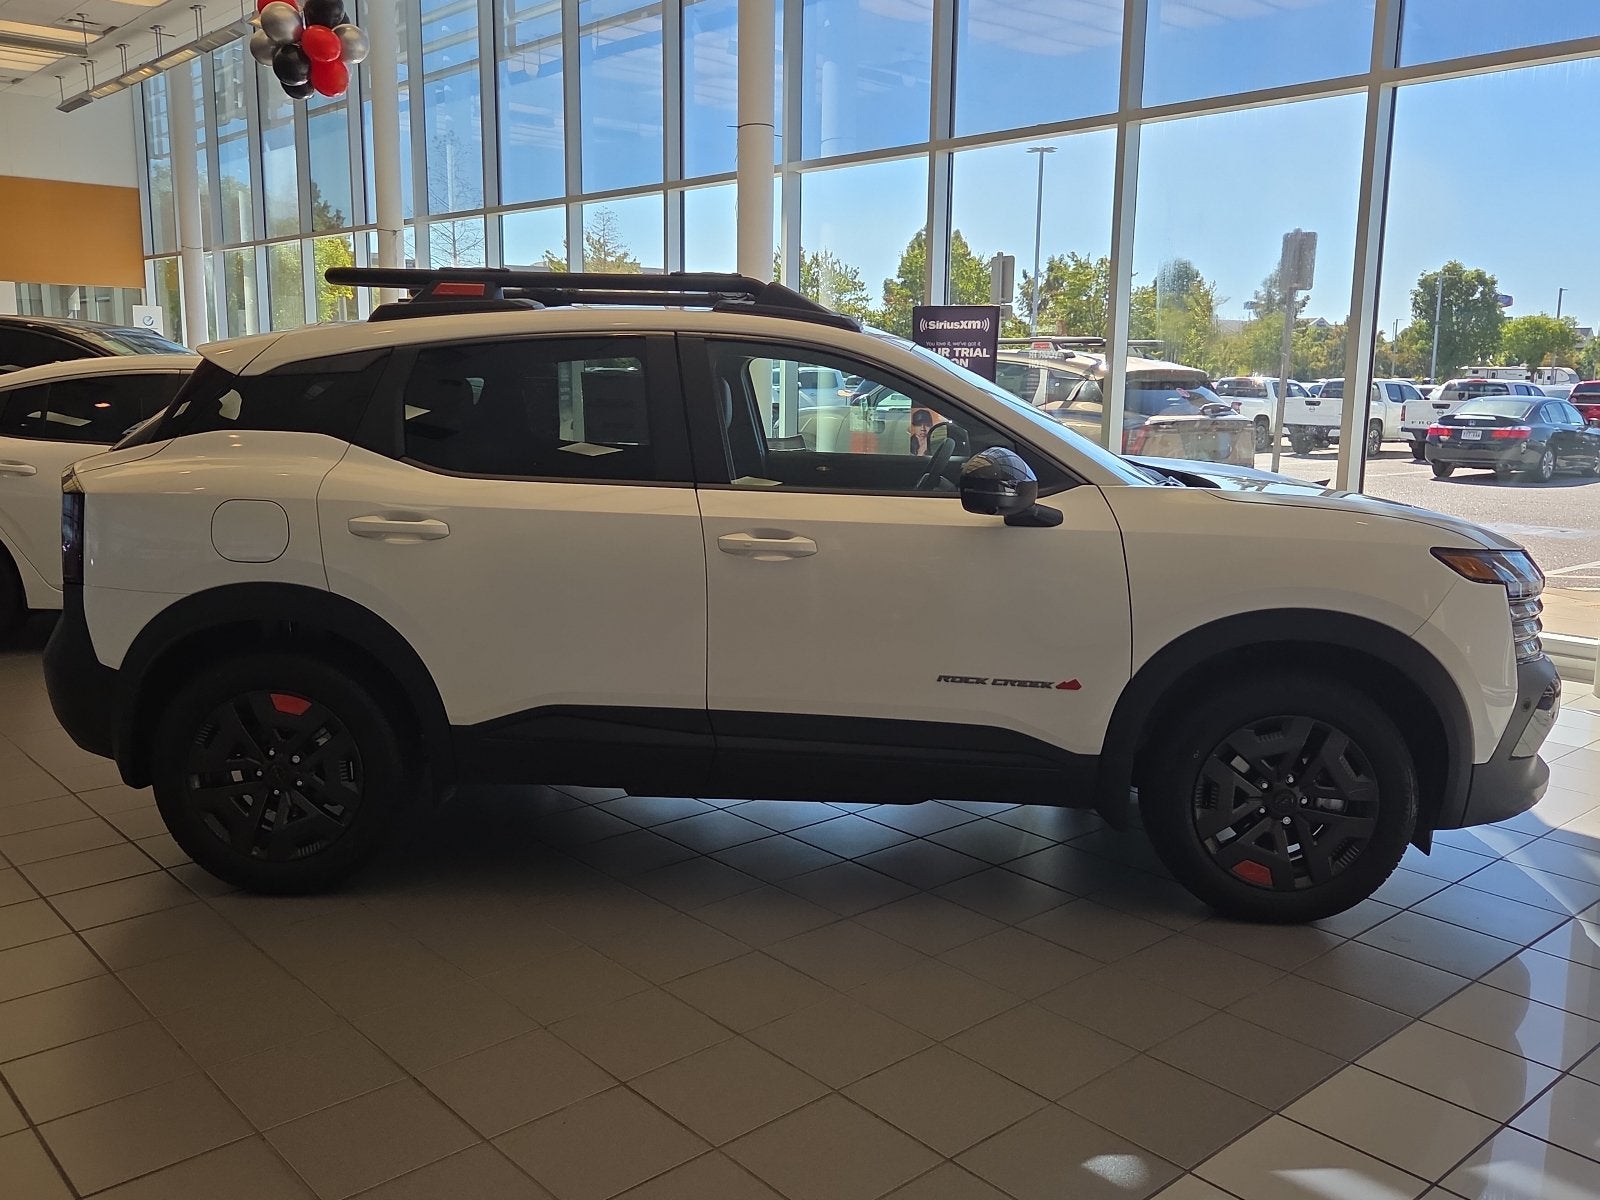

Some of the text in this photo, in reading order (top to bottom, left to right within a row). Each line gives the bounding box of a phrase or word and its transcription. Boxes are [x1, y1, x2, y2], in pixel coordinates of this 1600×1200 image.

[953, 347, 991, 358] TRIAL
[936, 674, 1055, 689] ROCK CREEK
